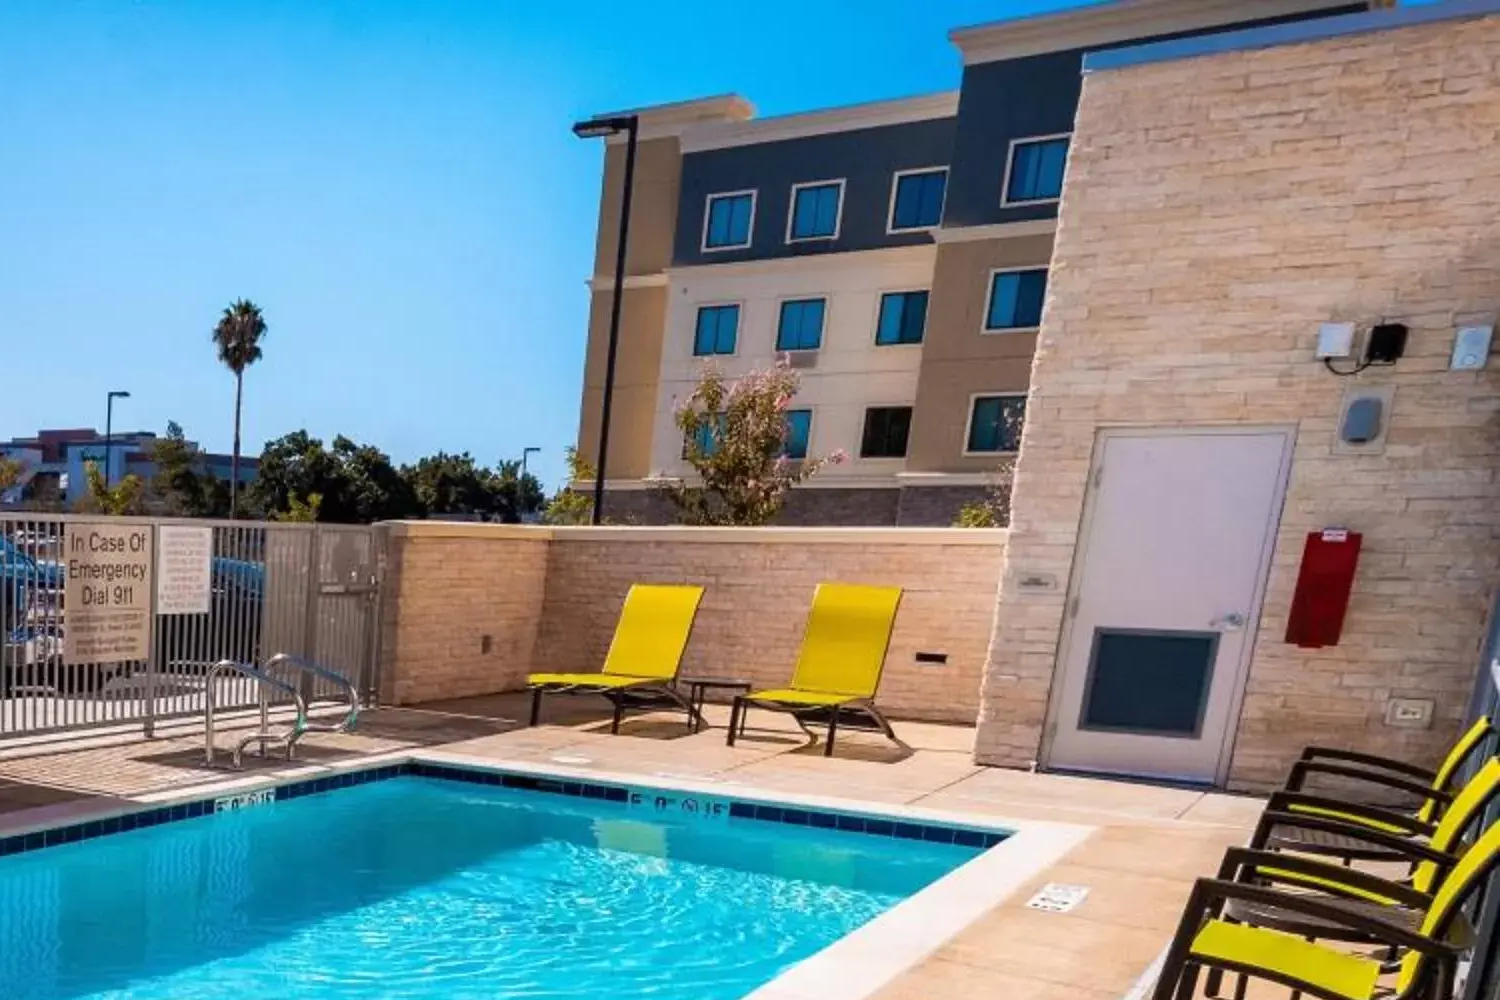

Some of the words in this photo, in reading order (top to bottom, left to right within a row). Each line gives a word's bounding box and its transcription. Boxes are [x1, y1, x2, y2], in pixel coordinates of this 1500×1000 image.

[71, 532, 85, 552] In
[89, 532, 125, 553] Case
[129, 533, 146, 553] Of
[69, 559, 147, 582] Emergency
[82, 585, 109, 605] Dial
[114, 585, 133, 605] 911
